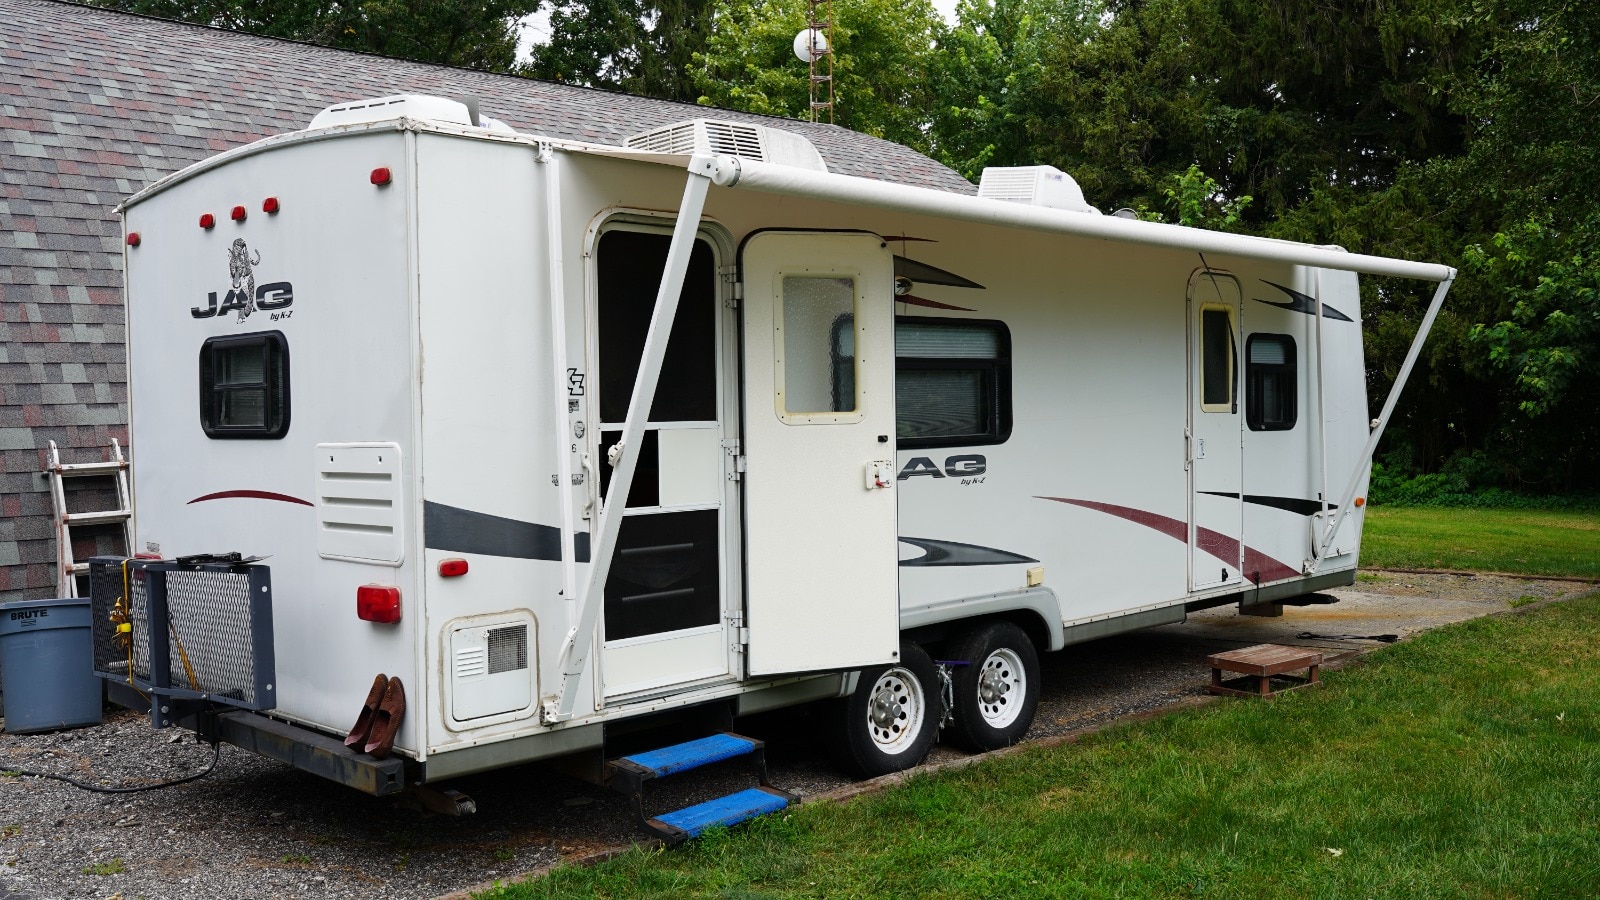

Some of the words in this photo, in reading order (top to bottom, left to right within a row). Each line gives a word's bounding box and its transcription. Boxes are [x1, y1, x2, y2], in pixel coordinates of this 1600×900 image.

[191, 282, 293, 319] JAG
[270, 312, 280, 321] by
[280, 311, 293, 319] K-Z
[897, 454, 986, 480] AG
[961, 478, 971, 486] by
[11, 609, 48, 621] BRUTE
